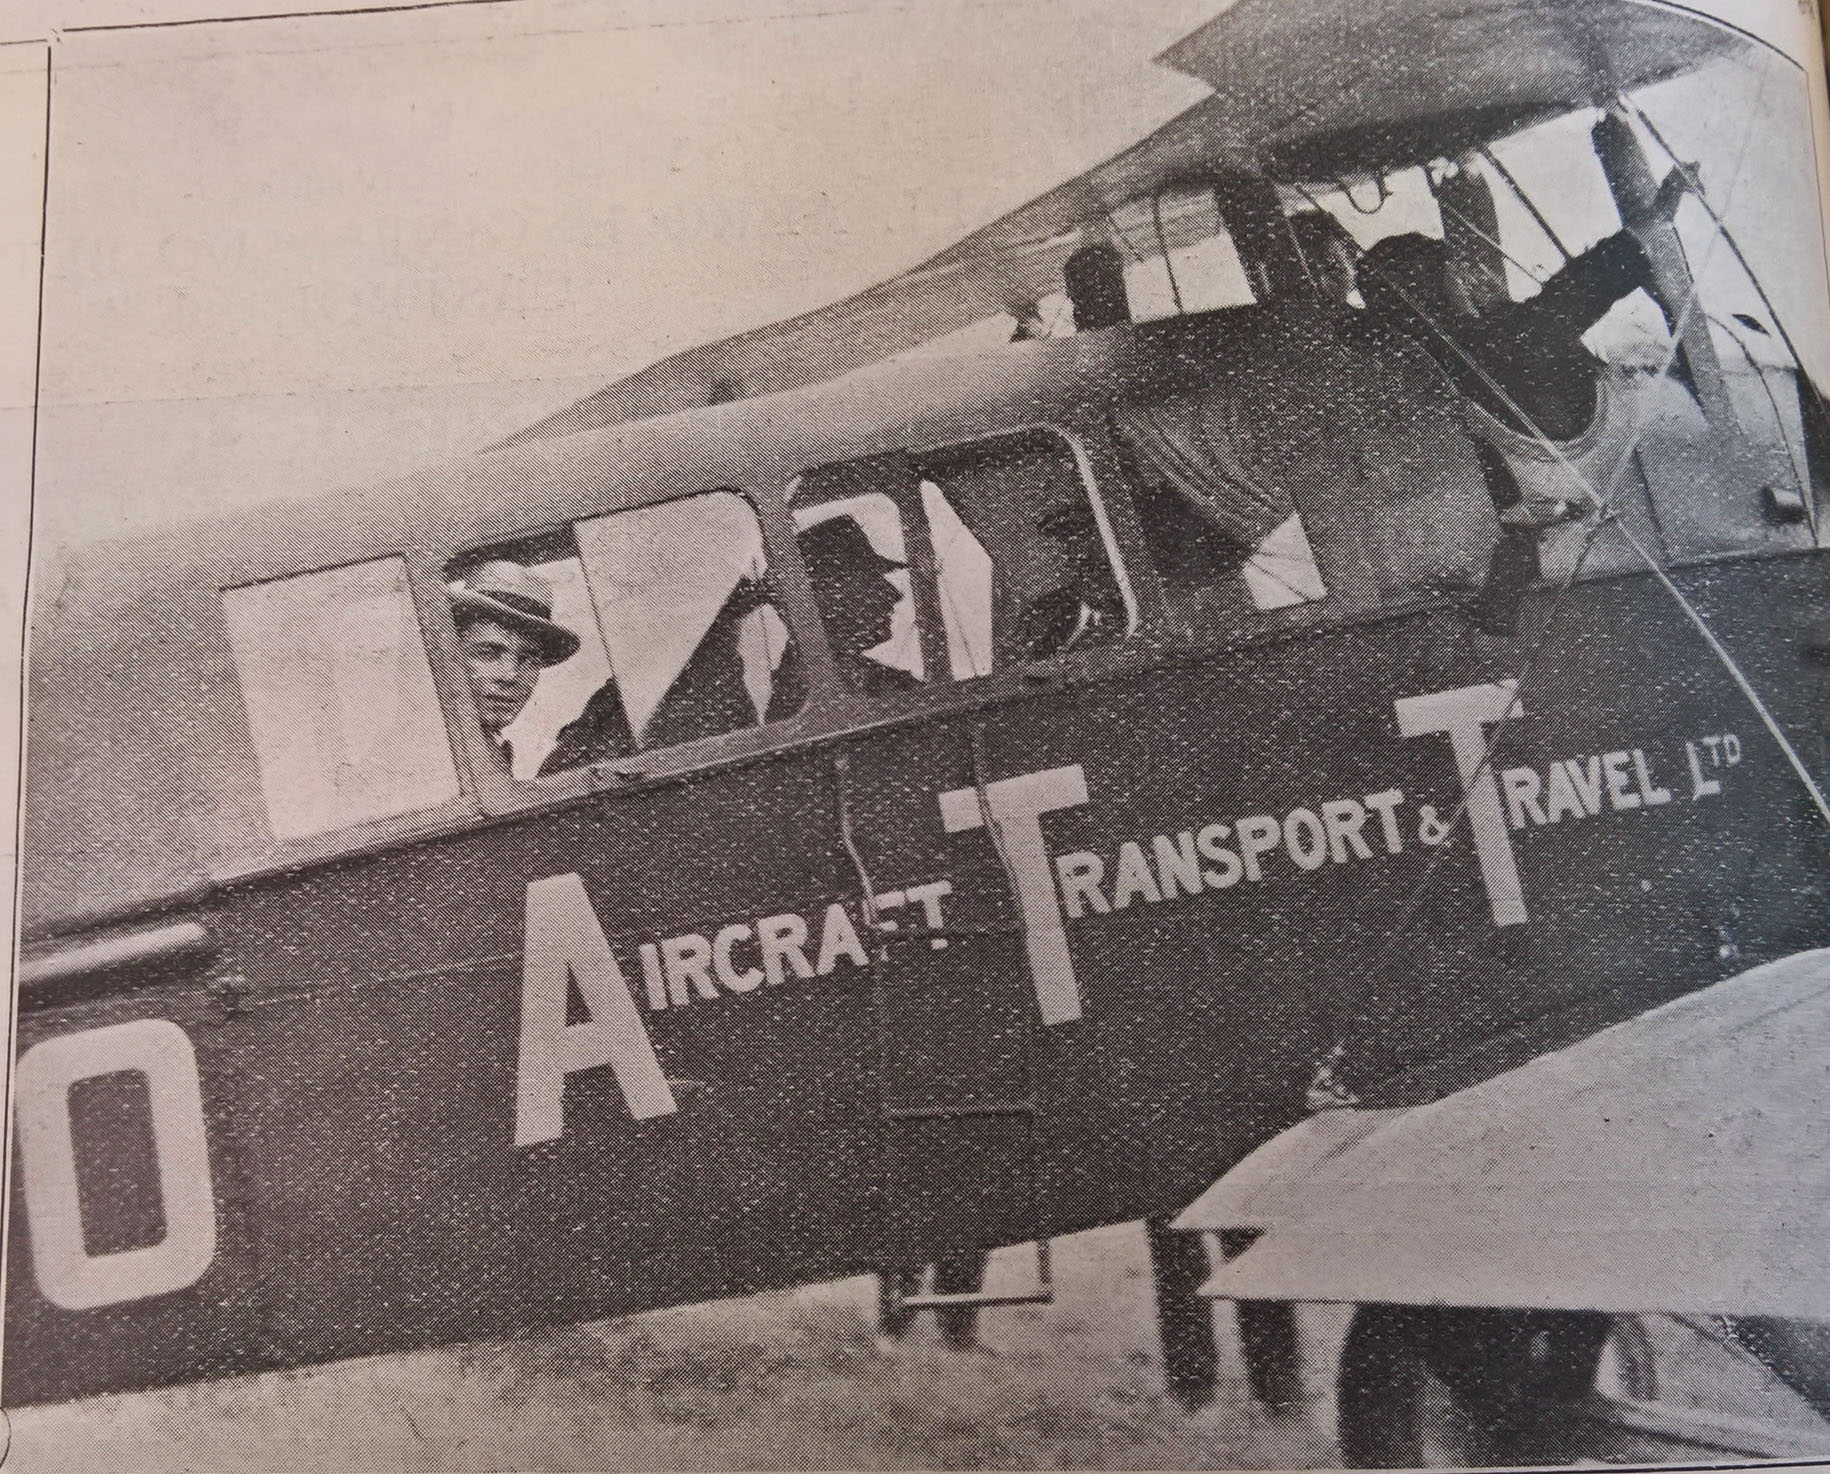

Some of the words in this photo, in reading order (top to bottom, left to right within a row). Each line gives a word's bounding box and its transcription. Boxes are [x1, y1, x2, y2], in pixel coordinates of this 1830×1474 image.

[938, 763, 1405, 1026] TRANSPORT
[1394, 679, 1671, 928] TRAVEL
[1418, 804, 1450, 847] &
